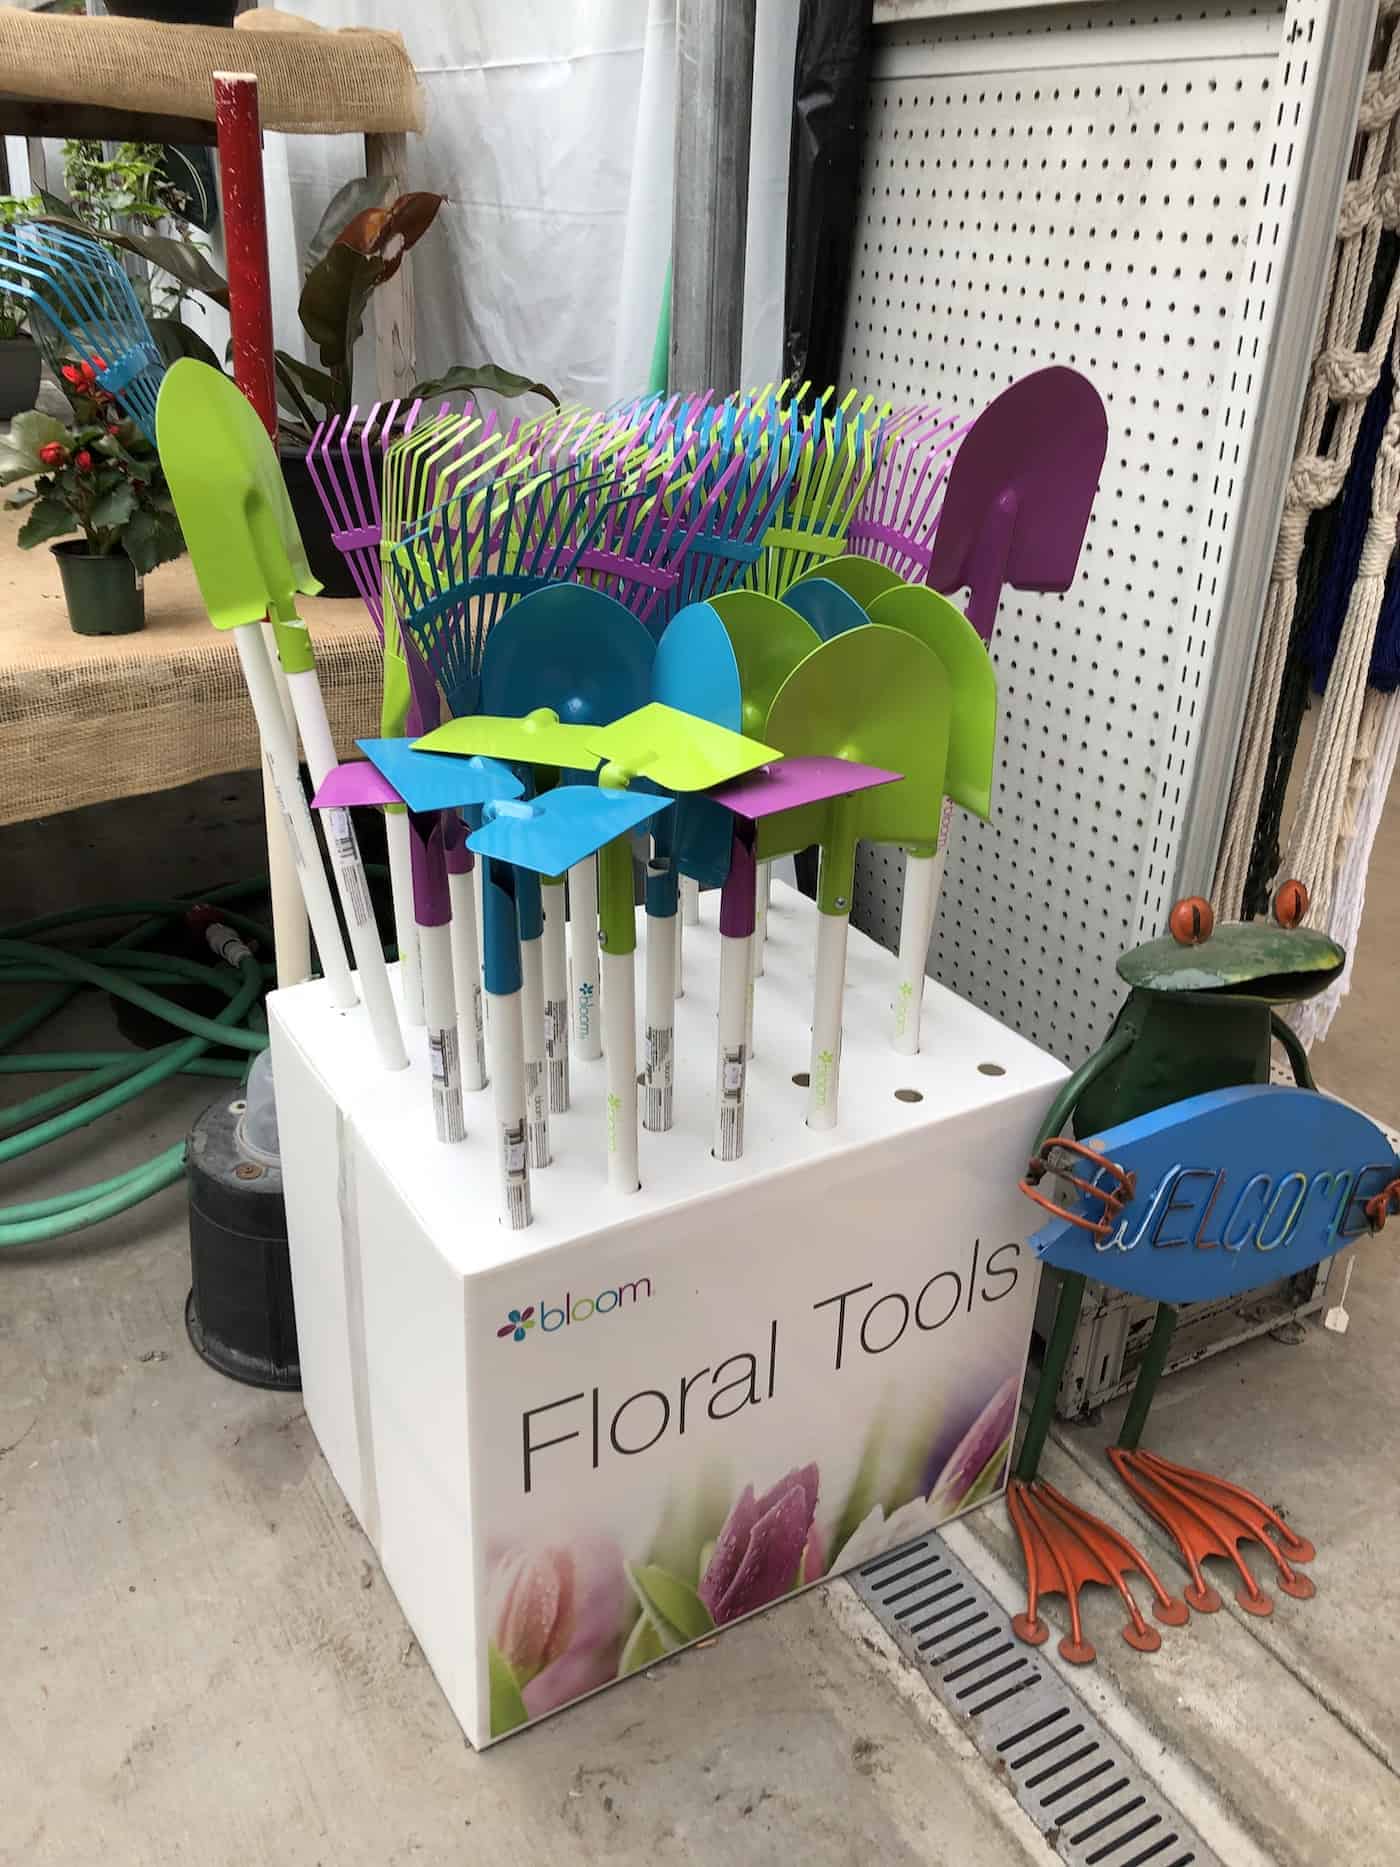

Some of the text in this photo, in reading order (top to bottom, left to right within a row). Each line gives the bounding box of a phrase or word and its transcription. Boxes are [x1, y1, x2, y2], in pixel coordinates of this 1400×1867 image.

[579, 996, 593, 1035] bloom
[1087, 1163, 1393, 1251] WELCOME
[541, 1278, 650, 1332] bloom
[523, 1239, 1020, 1492] Floral Tools
